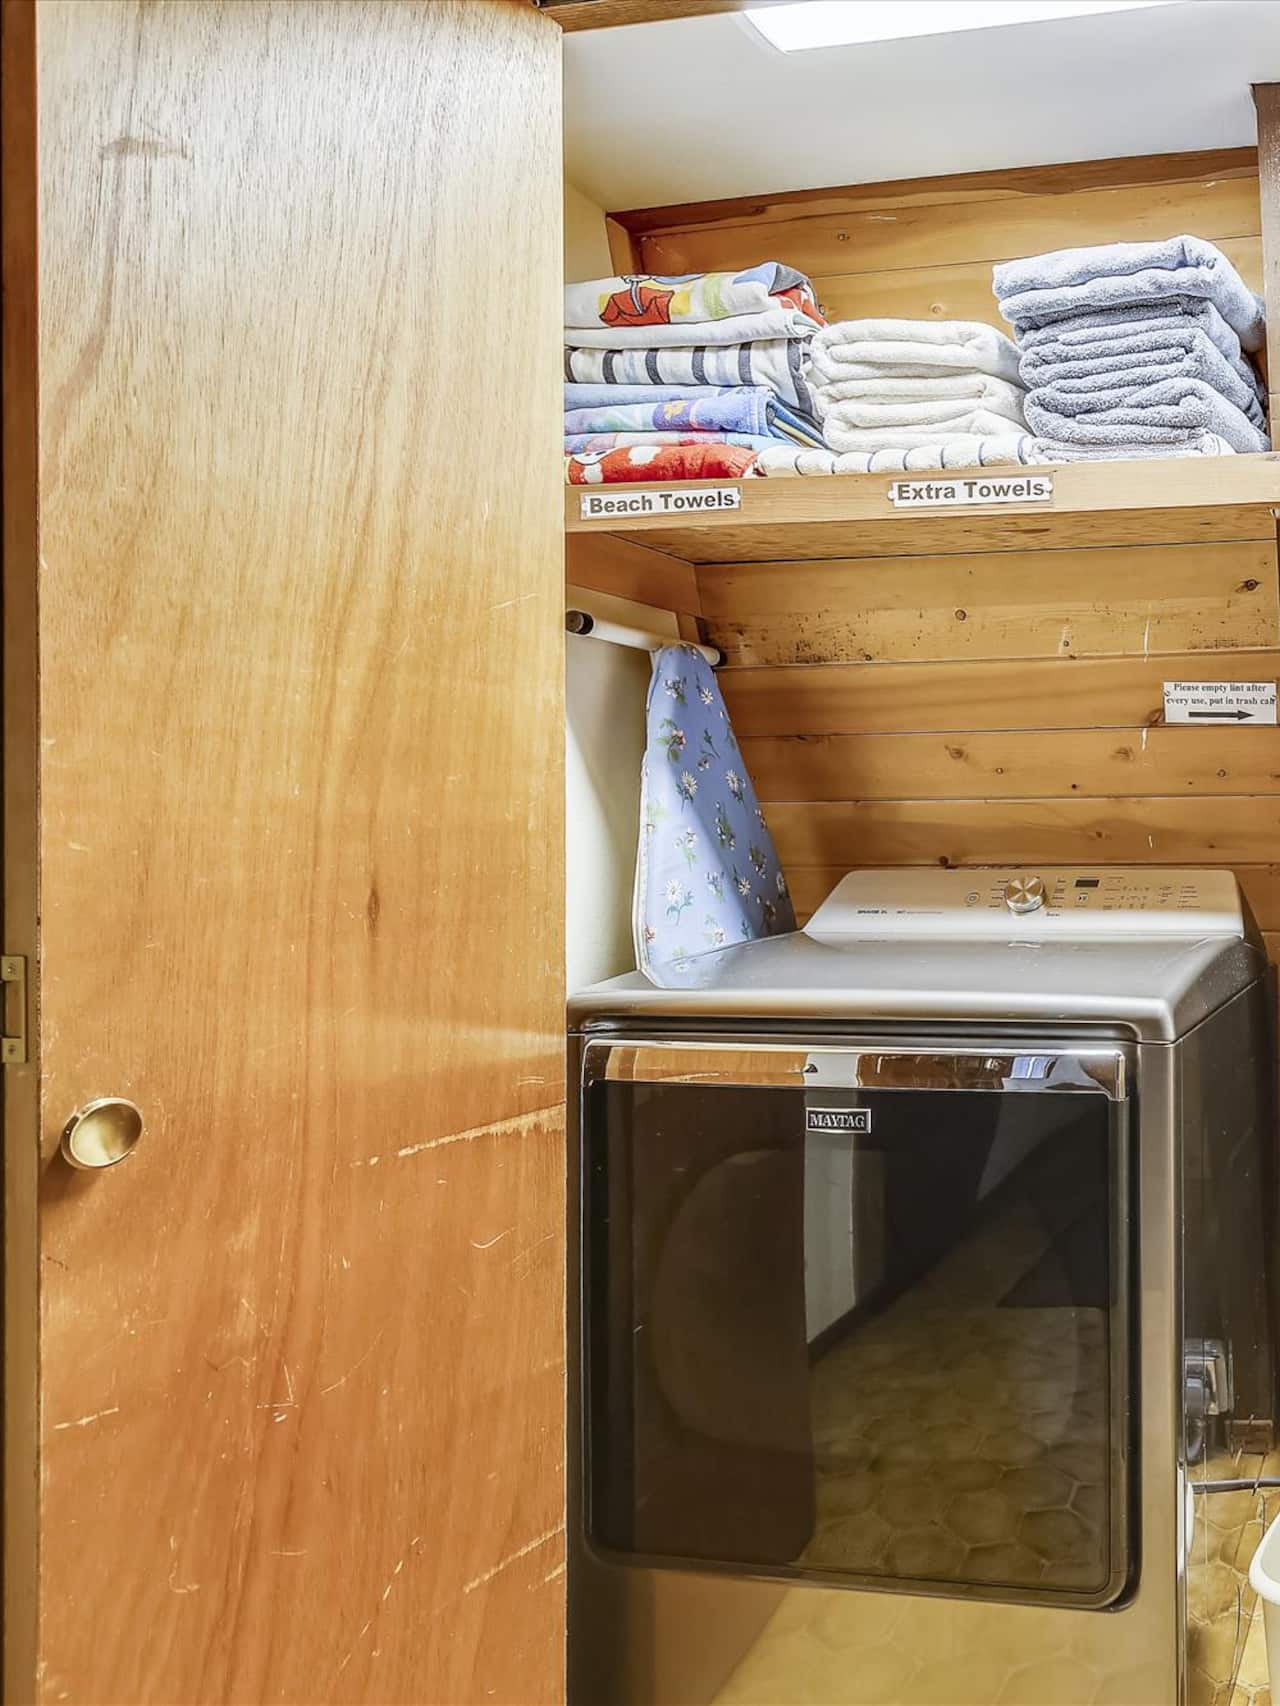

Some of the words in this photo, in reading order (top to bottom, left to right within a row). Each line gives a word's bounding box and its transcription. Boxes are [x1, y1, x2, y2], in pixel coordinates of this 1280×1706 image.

[897, 483, 956, 500] Extra
[963, 480, 1045, 498] Towels
[589, 495, 653, 514] Beach
[659, 491, 735, 510] Towels
[1174, 683, 1199, 692] Please
[1201, 684, 1227, 693] empty
[1229, 683, 1244, 692] lint
[1246, 683, 1267, 692] after
[1166, 697, 1188, 706] every
[1209, 697, 1224, 707] put
[1225, 696, 1234, 705] in
[1236, 696, 1258, 705] trash
[809, 1113, 865, 1128] MAYTAG
